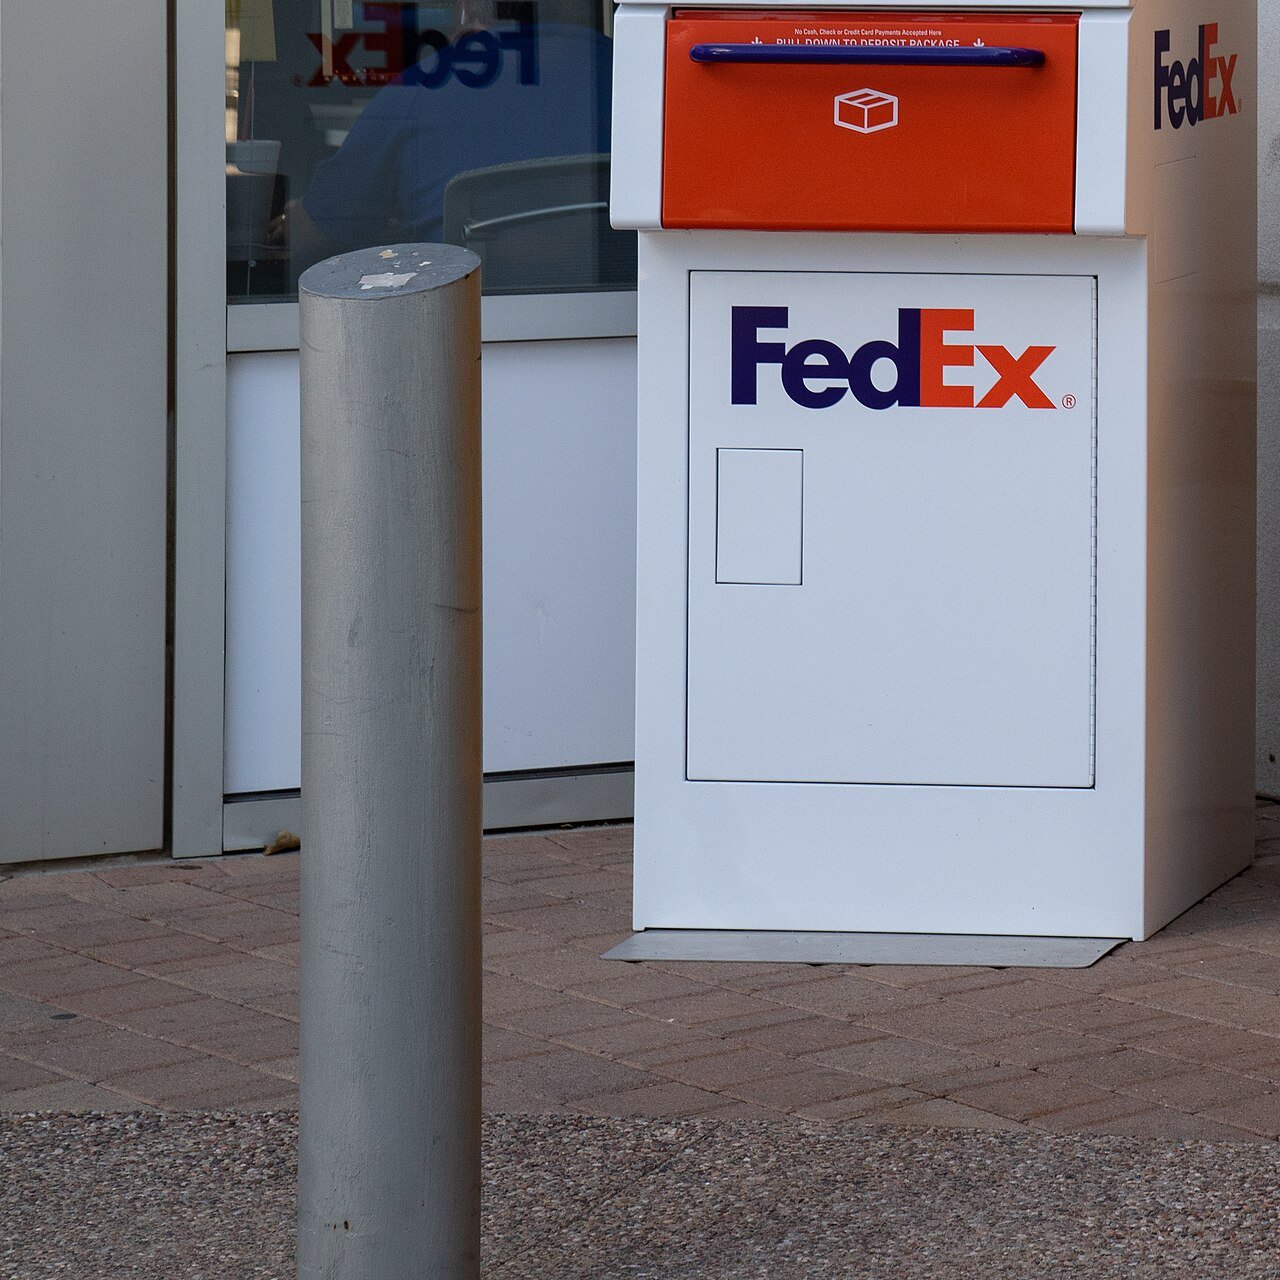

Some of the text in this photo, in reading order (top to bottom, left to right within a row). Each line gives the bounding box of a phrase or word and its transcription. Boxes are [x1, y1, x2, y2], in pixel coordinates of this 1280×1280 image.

[875, 29, 901, 37] Payments
[1154, 22, 1238, 130] FedEx
[731, 306, 1057, 410] FedEx
